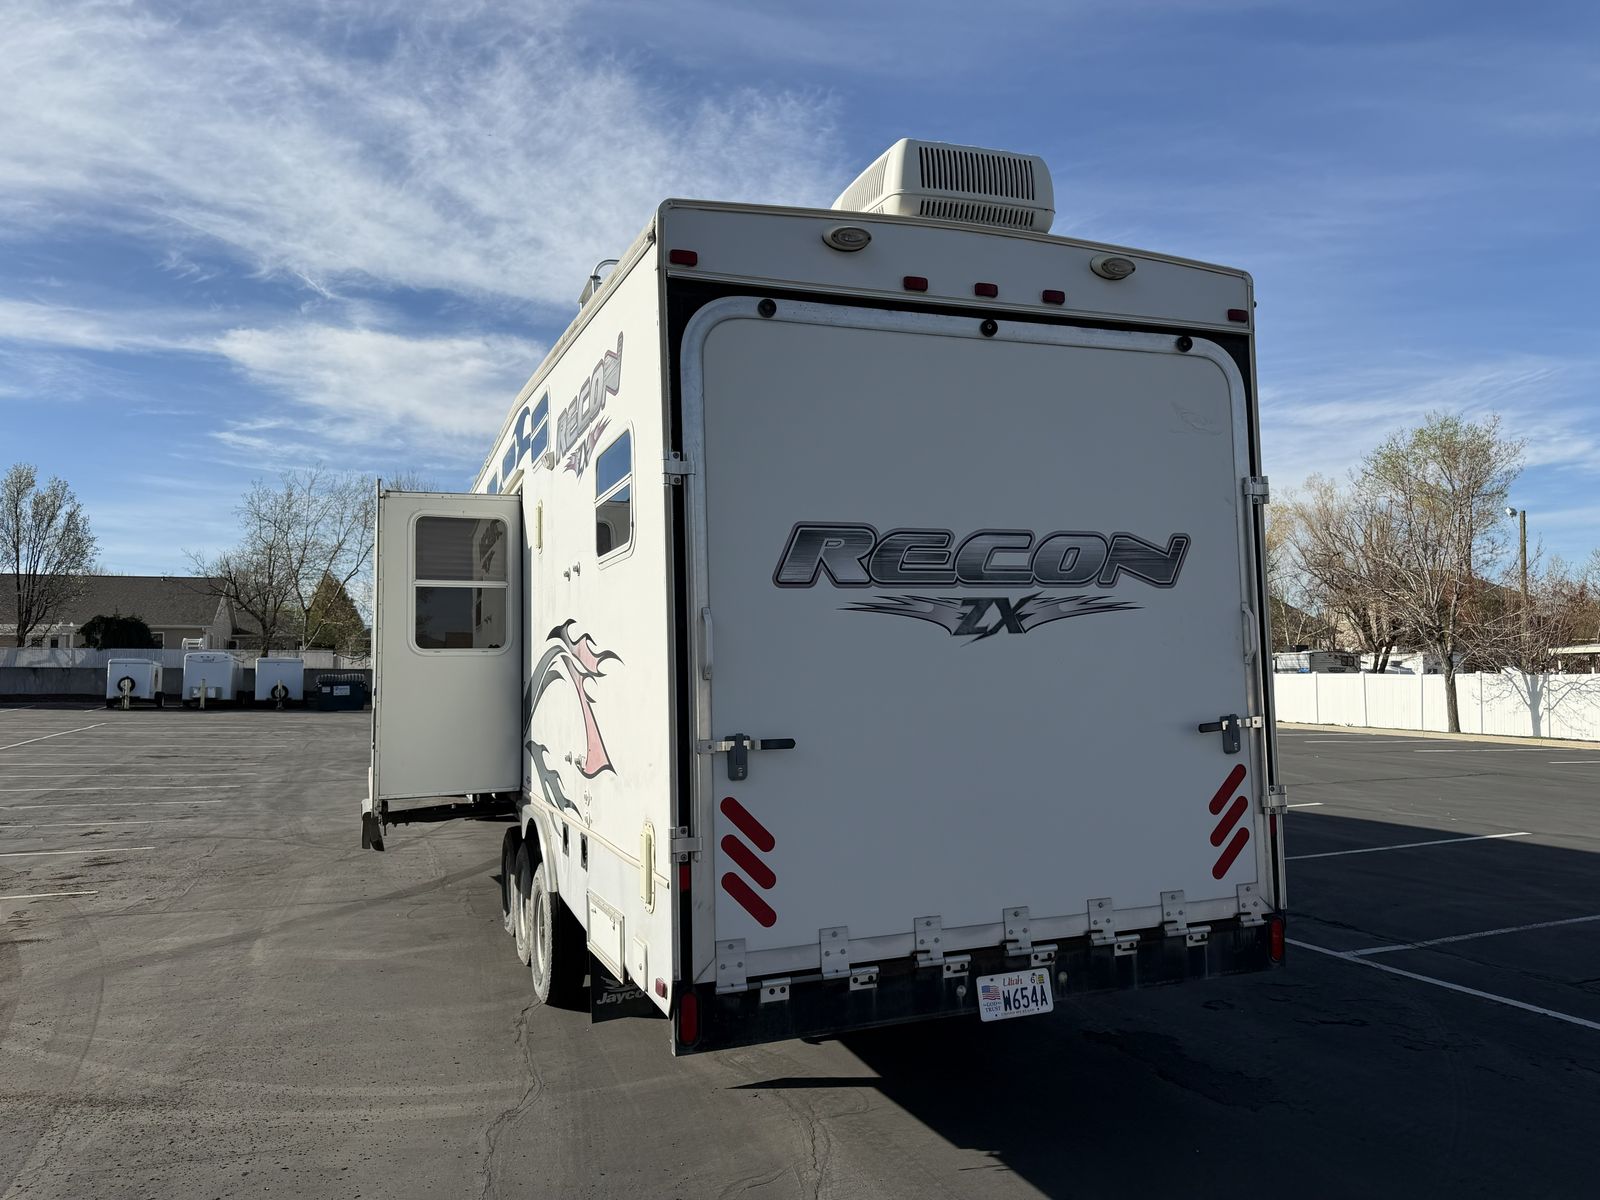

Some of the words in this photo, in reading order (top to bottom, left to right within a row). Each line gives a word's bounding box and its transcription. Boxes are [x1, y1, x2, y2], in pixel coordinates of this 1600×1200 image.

[556, 331, 624, 466] RECON
[773, 521, 1192, 589] RECON
[951, 592, 1041, 642] ZX
[1003, 975, 1023, 987] Utah
[1030, 976, 1036, 984] 6
[596, 990, 645, 1005] Jayco
[1002, 985, 1049, 1012] W654A
